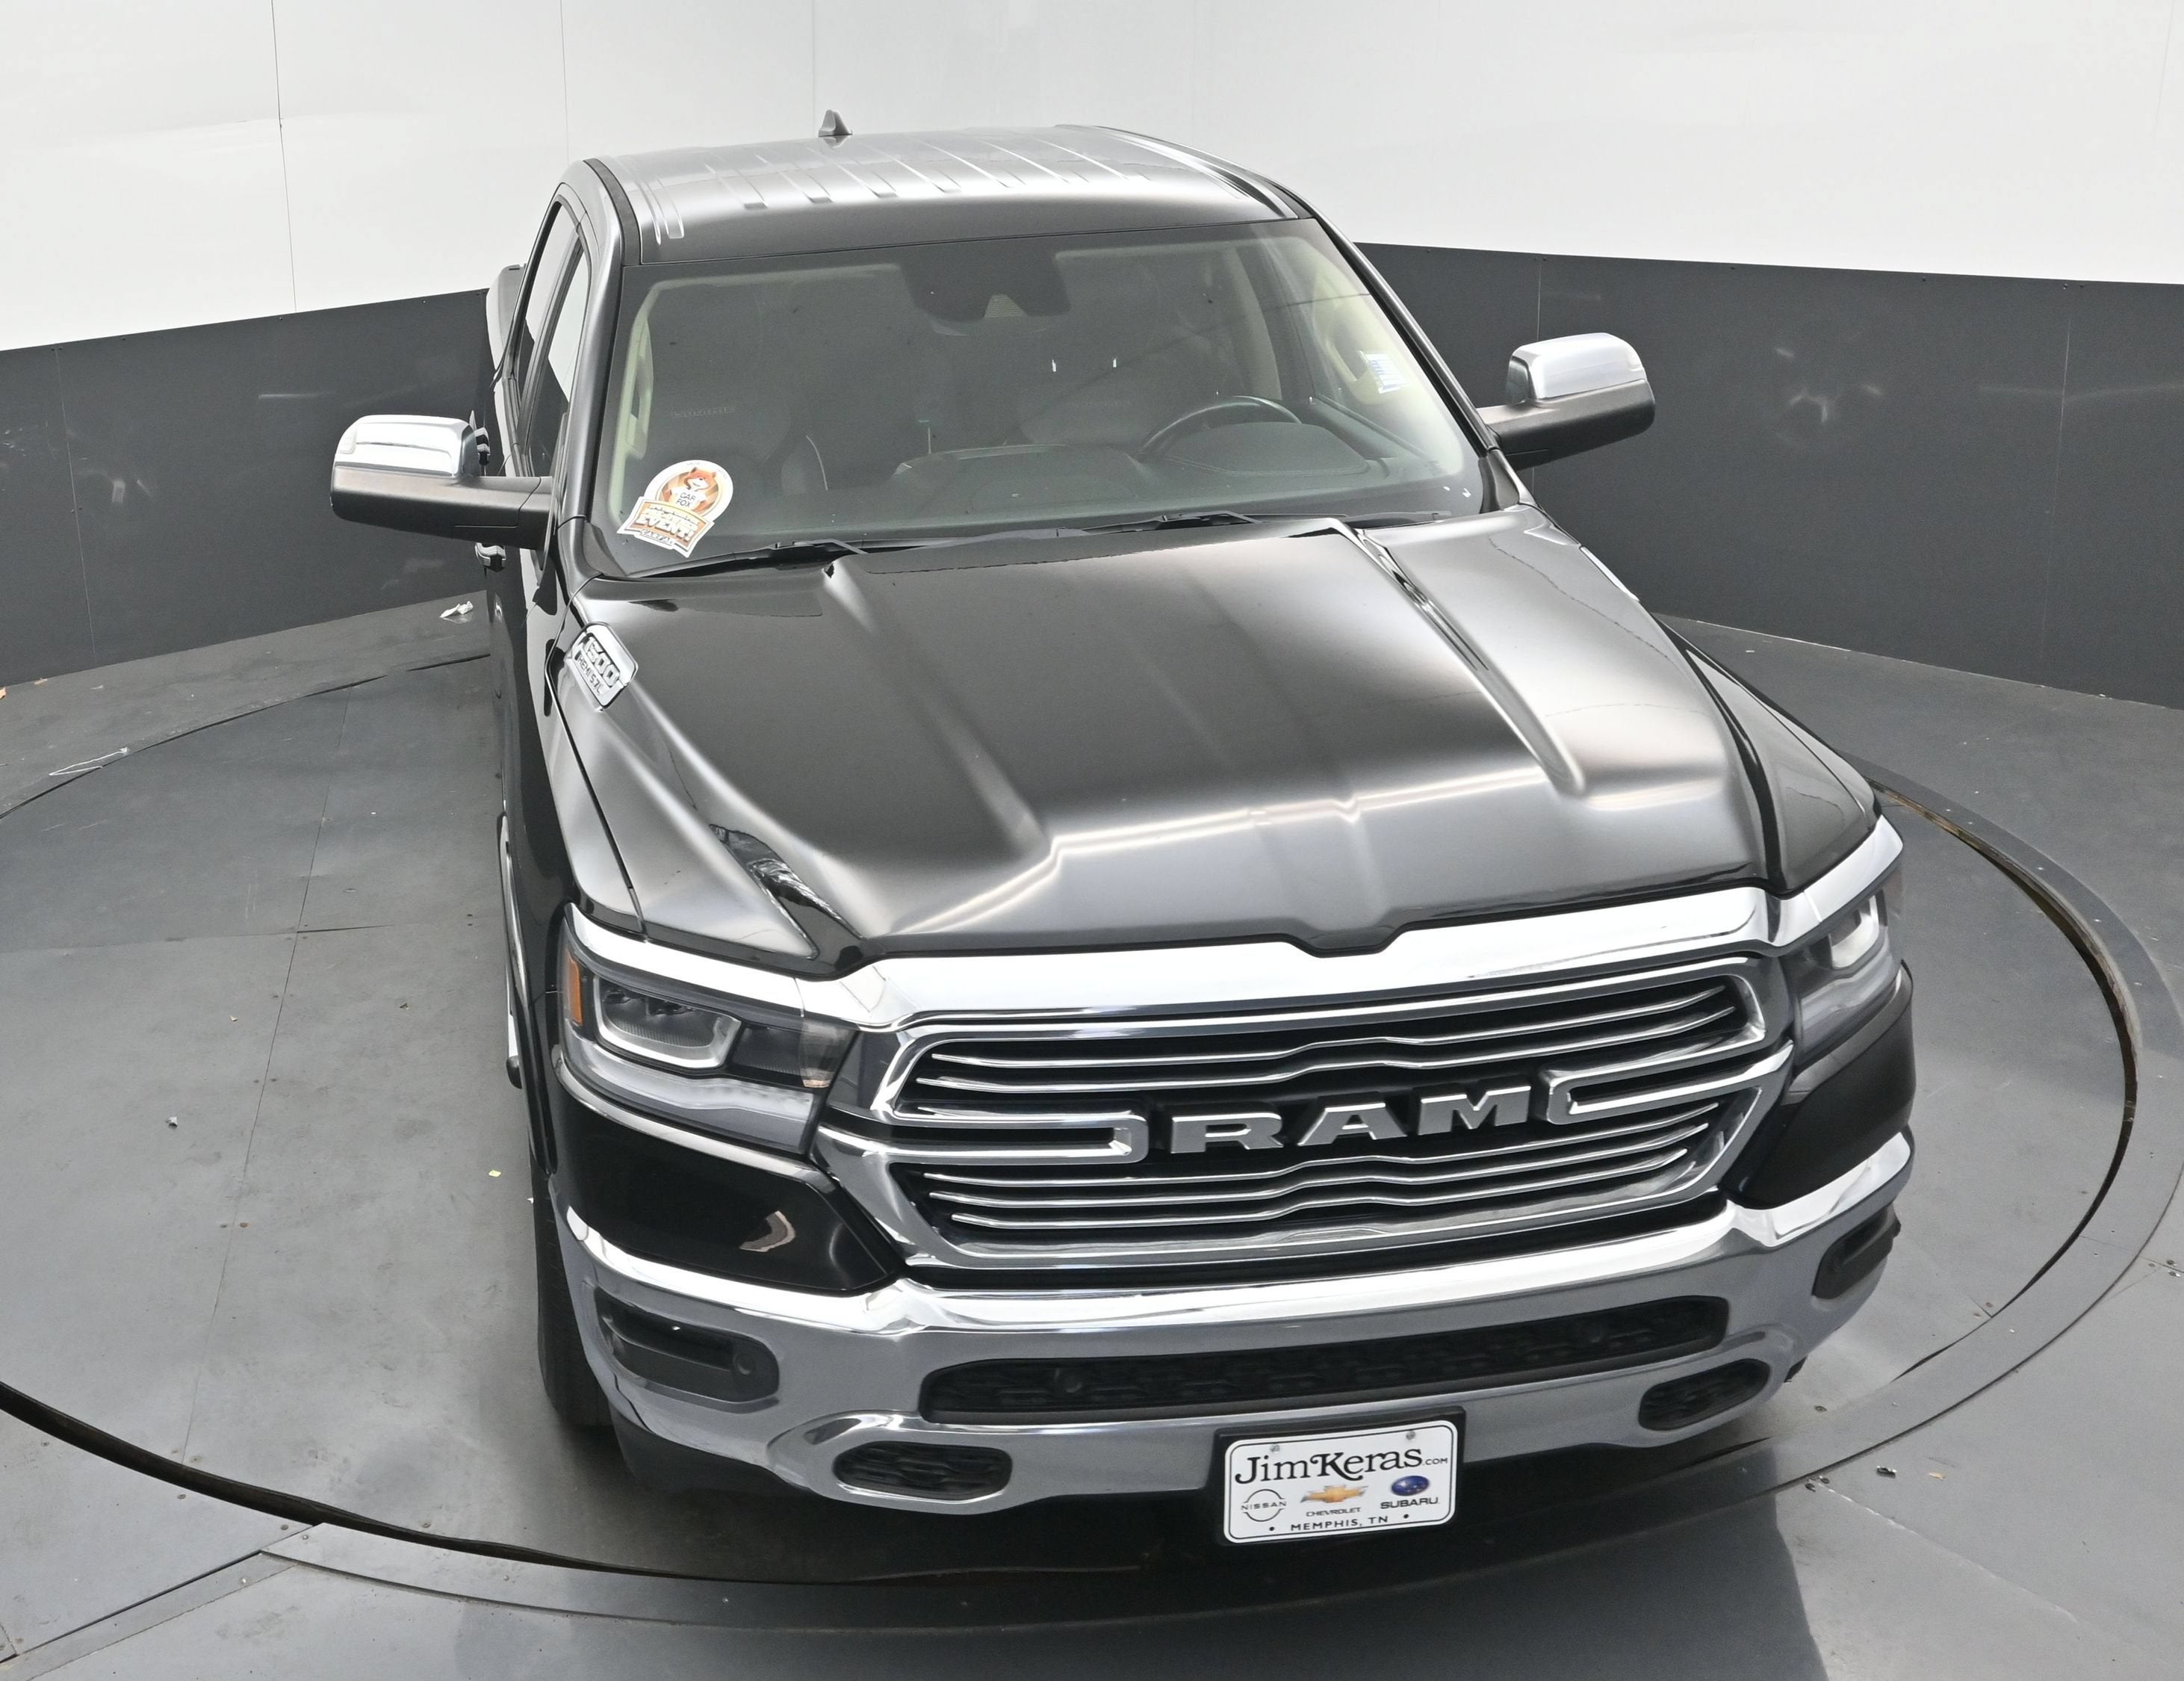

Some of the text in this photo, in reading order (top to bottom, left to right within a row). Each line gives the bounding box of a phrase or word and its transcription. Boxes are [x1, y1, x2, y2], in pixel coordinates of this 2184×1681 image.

[676, 498, 692, 507] FOX
[680, 492, 696, 502] CAR
[577, 655, 593, 676] HEMI
[1170, 1086, 1531, 1154] RAM
[1241, 1501, 1286, 1511] NISSAN
[1380, 1497, 1439, 1509] SUBARU
[1306, 1507, 1361, 1517] CHEVROLET
[1291, 1515, 1389, 1532] MEMPHIS, TN
